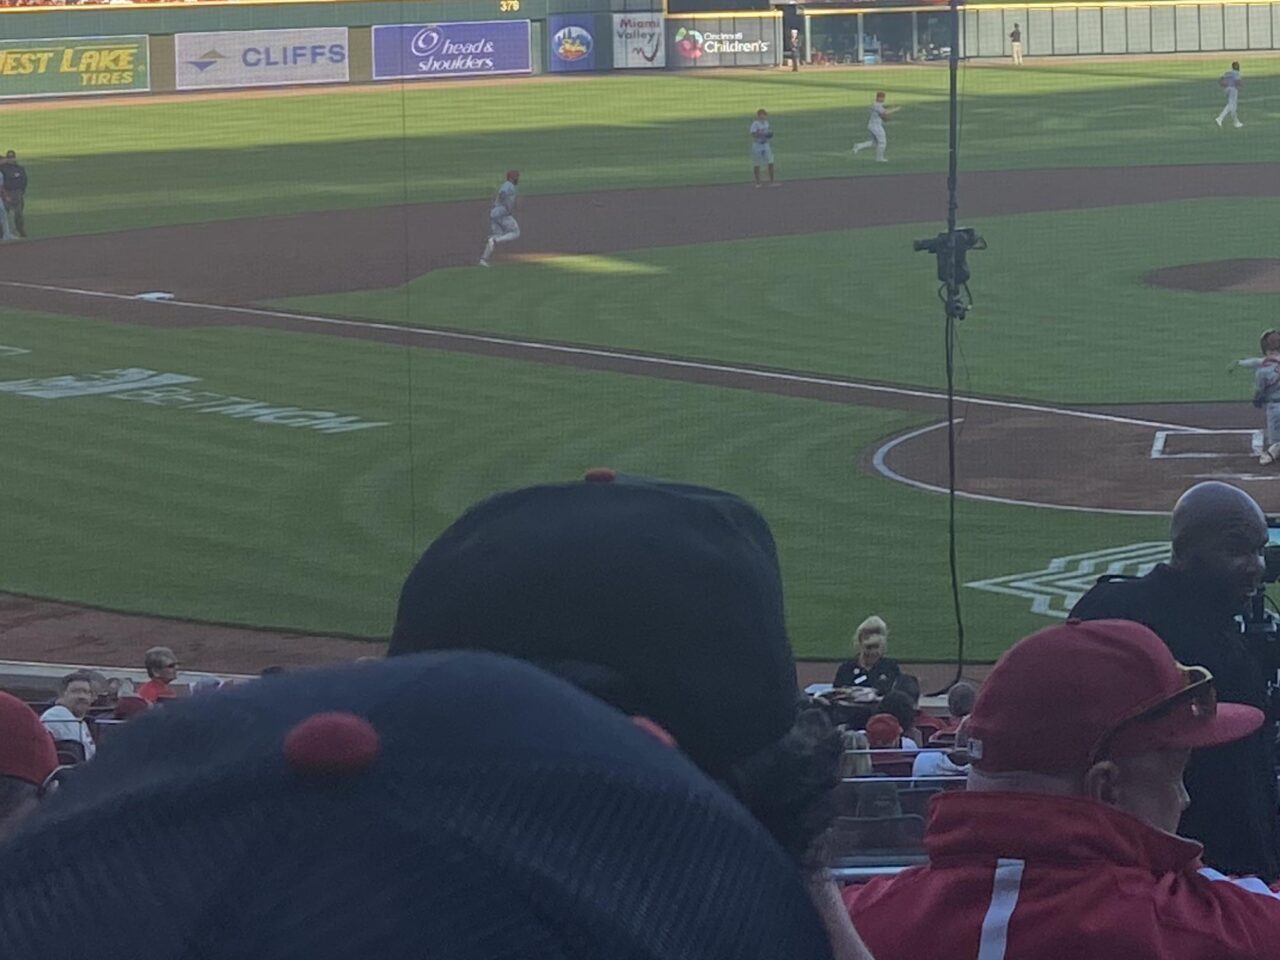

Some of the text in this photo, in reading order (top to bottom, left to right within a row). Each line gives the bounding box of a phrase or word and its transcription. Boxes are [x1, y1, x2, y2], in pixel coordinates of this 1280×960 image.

[619, 18, 661, 29] Miami
[616, 30, 656, 45] Valley
[441, 38, 485, 55] head
[704, 40, 769, 54] Children's
[60, 47, 139, 73] LAKE
[241, 44, 346, 67] CLIFFS
[417, 55, 495, 72] shoulders
[80, 71, 134, 86] TIRES
